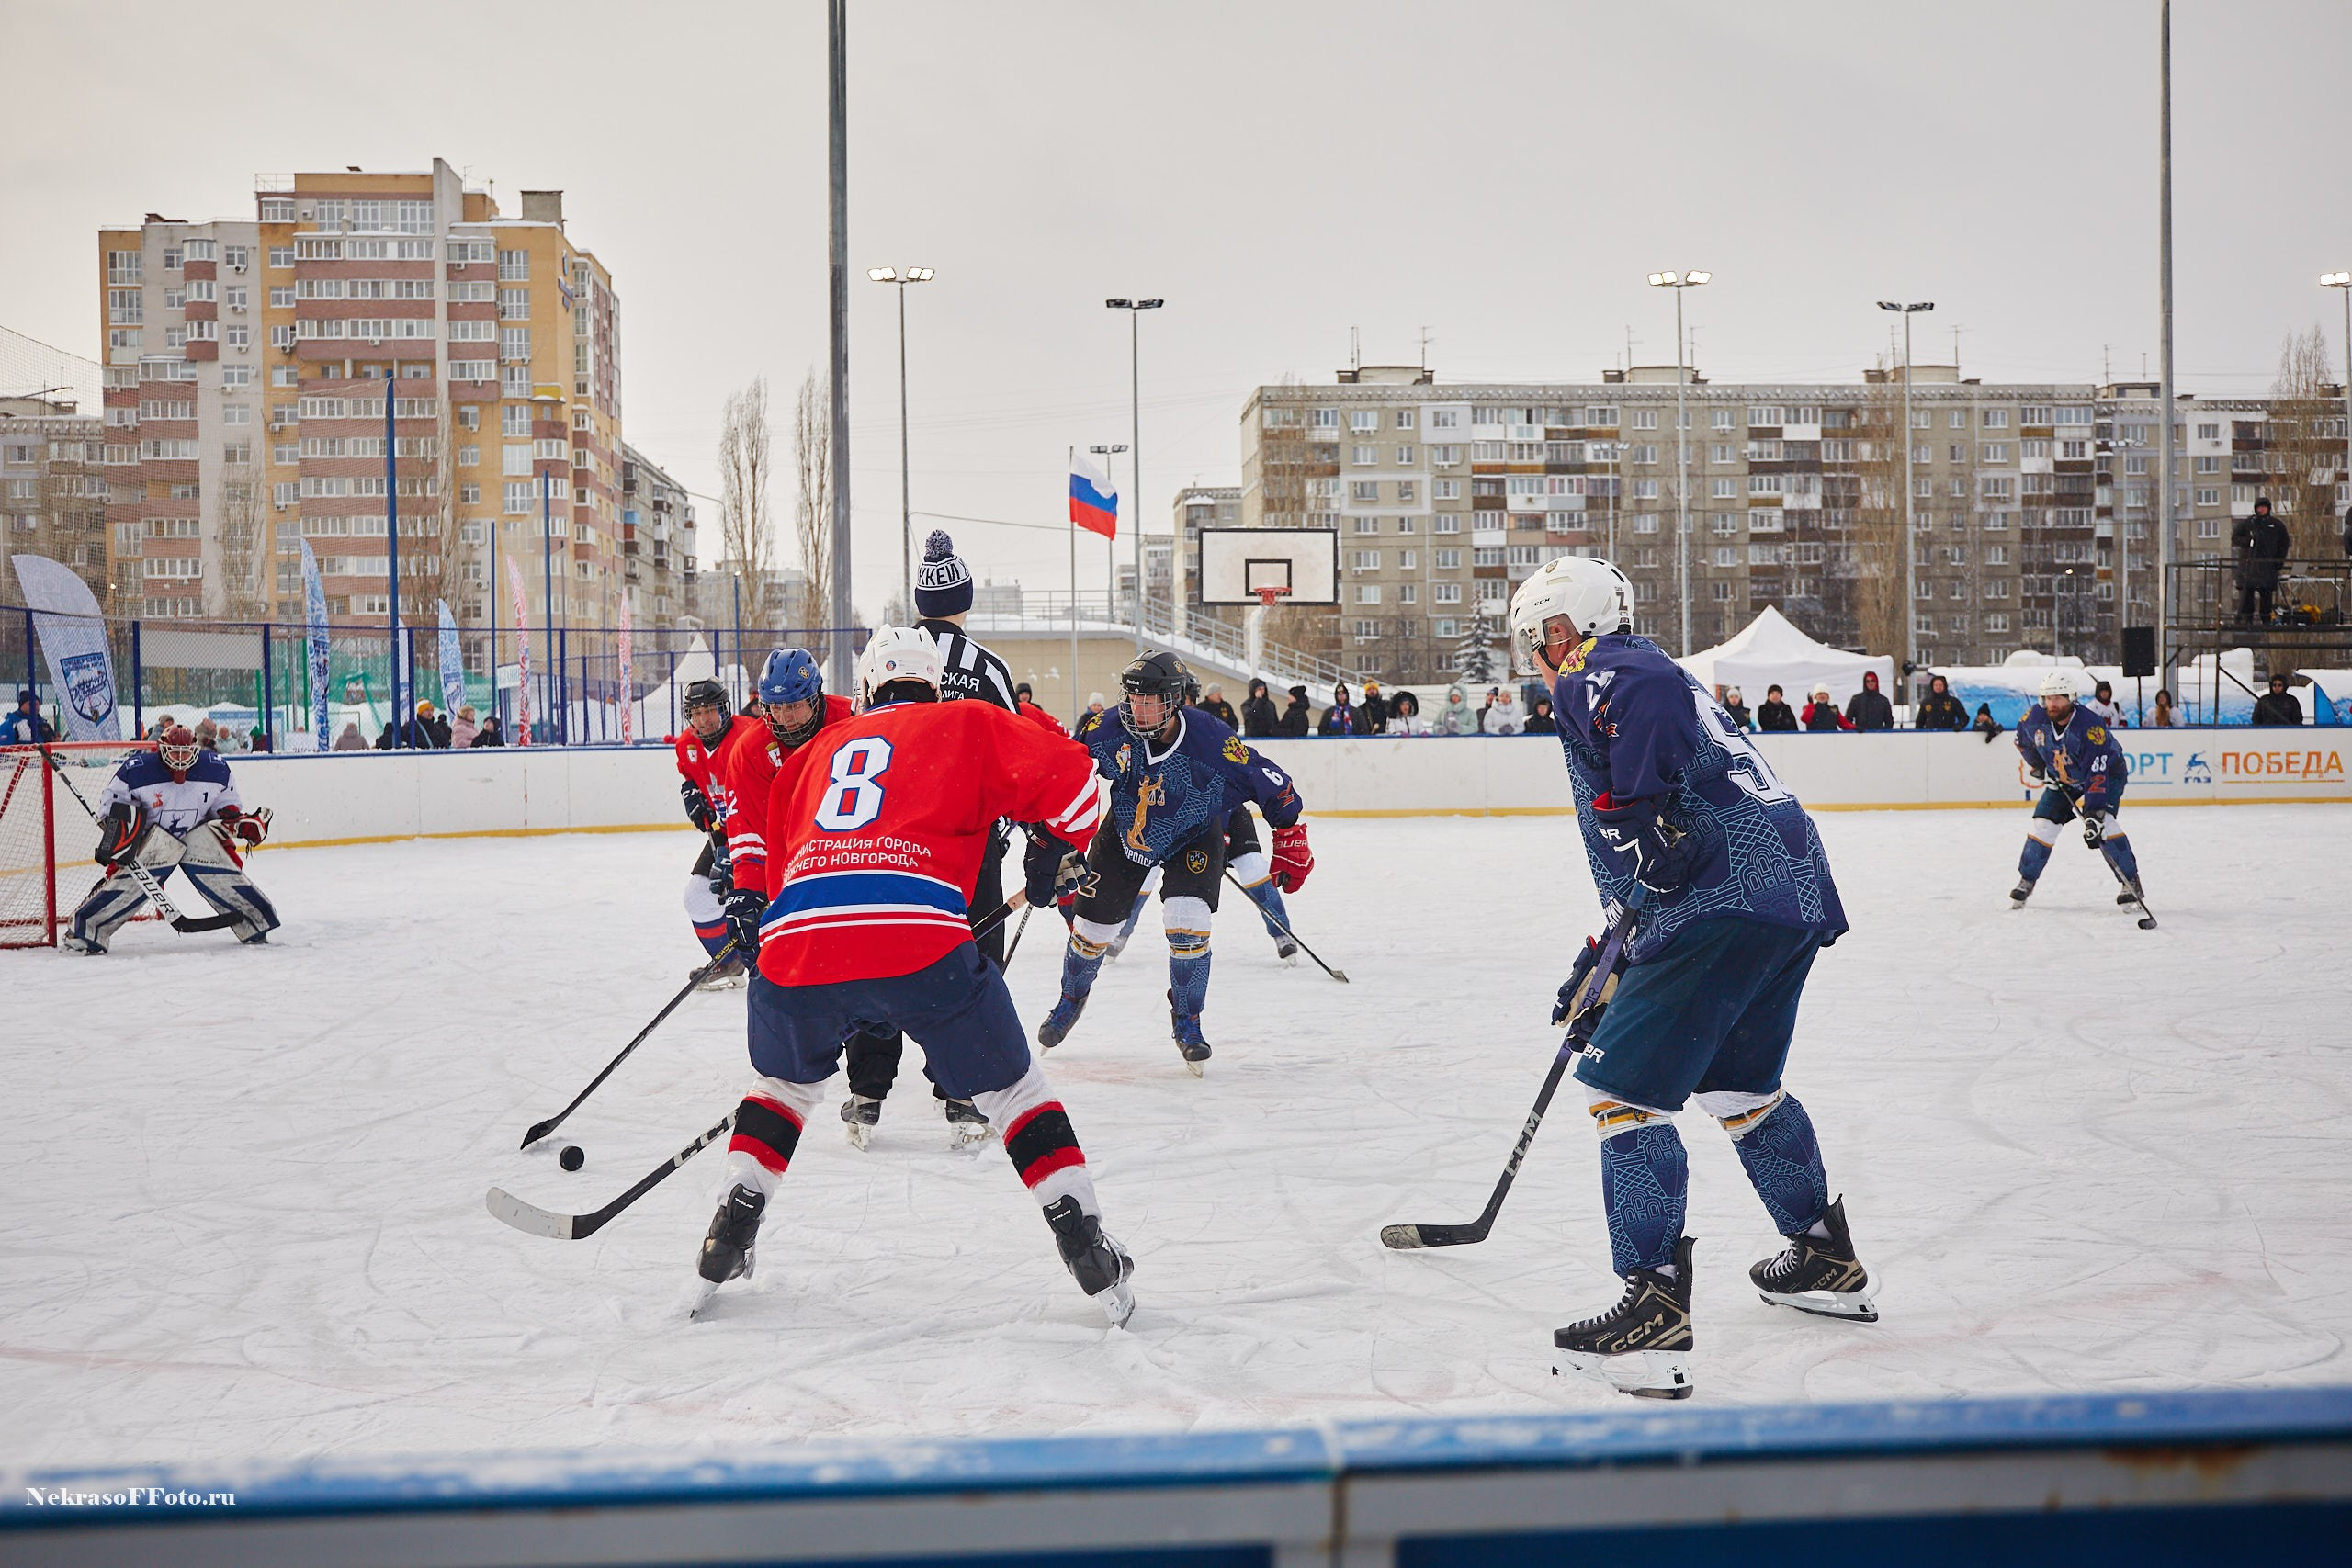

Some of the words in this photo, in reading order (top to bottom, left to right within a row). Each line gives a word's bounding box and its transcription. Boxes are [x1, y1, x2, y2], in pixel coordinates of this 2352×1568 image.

[919, 561, 961, 585] ККЕЙ
[1534, 597, 1551, 606] CCM
[939, 673, 980, 692] СКАЯ
[2222, 750, 2345, 779] ПОБЕДА
[814, 735, 895, 832] 8
[1261, 766, 1284, 787] 6
[202, 792, 209, 803] 1
[876, 837, 932, 858] ГОРОДА
[1272, 839, 1308, 851] AUER
[831, 852, 919, 868] НОВГОРОДА
[128, 860, 175, 915] BAUER
[715, 937, 739, 962] TACKS
[1506, 1110, 1544, 1178] CCM
[734, 1197, 755, 1210] TRUE
[1051, 1209, 1072, 1222] TRUE
[1810, 1267, 1838, 1290] CCM
[1610, 1311, 1665, 1353] CCM
